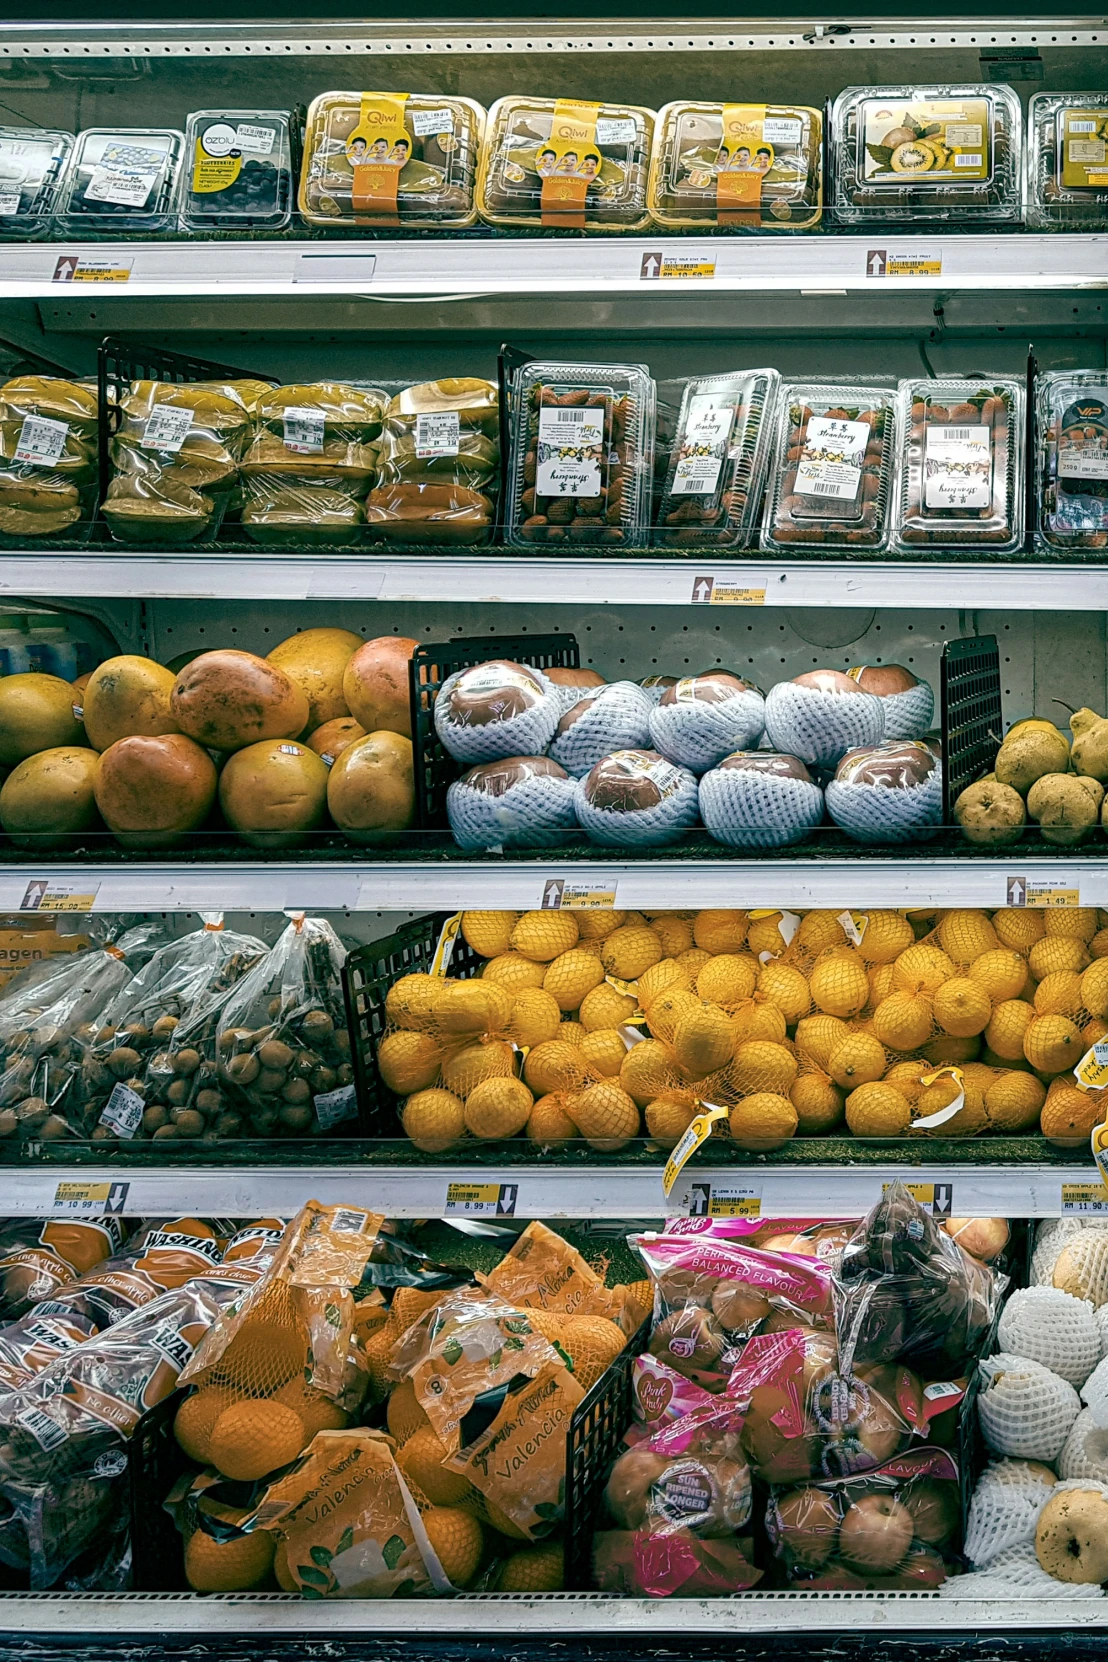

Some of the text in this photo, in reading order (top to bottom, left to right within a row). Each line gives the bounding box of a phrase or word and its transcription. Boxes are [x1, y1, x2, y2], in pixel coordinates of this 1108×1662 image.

[367, 111, 397, 124] Qiwi
[558, 126, 588, 139] Qiwi
[728, 121, 759, 134] Qiwi
[1077, 406, 1102, 416] VIP
[817, 429, 856, 444] Strawberry
[550, 470, 590, 484] Strawberry
[938, 483, 978, 496] Strawberry
[464, 1202, 484, 1210] 8.99
[1079, 1202, 1102, 1210] 11.90
[145, 1231, 223, 1264] WASHING
[691, 1259, 804, 1300] BALANCED FLAVOUR
[641, 1381, 667, 1398] Pink
[831, 1379, 839, 1421] LONGER
[103, 1405, 133, 1427] other
[496, 1408, 566, 1480] Valencia
[677, 1475, 699, 1487] SUN
[305, 1466, 376, 1524] Valencia
[665, 1483, 708, 1499] RIPENED
[664, 1493, 706, 1510] LONGER
